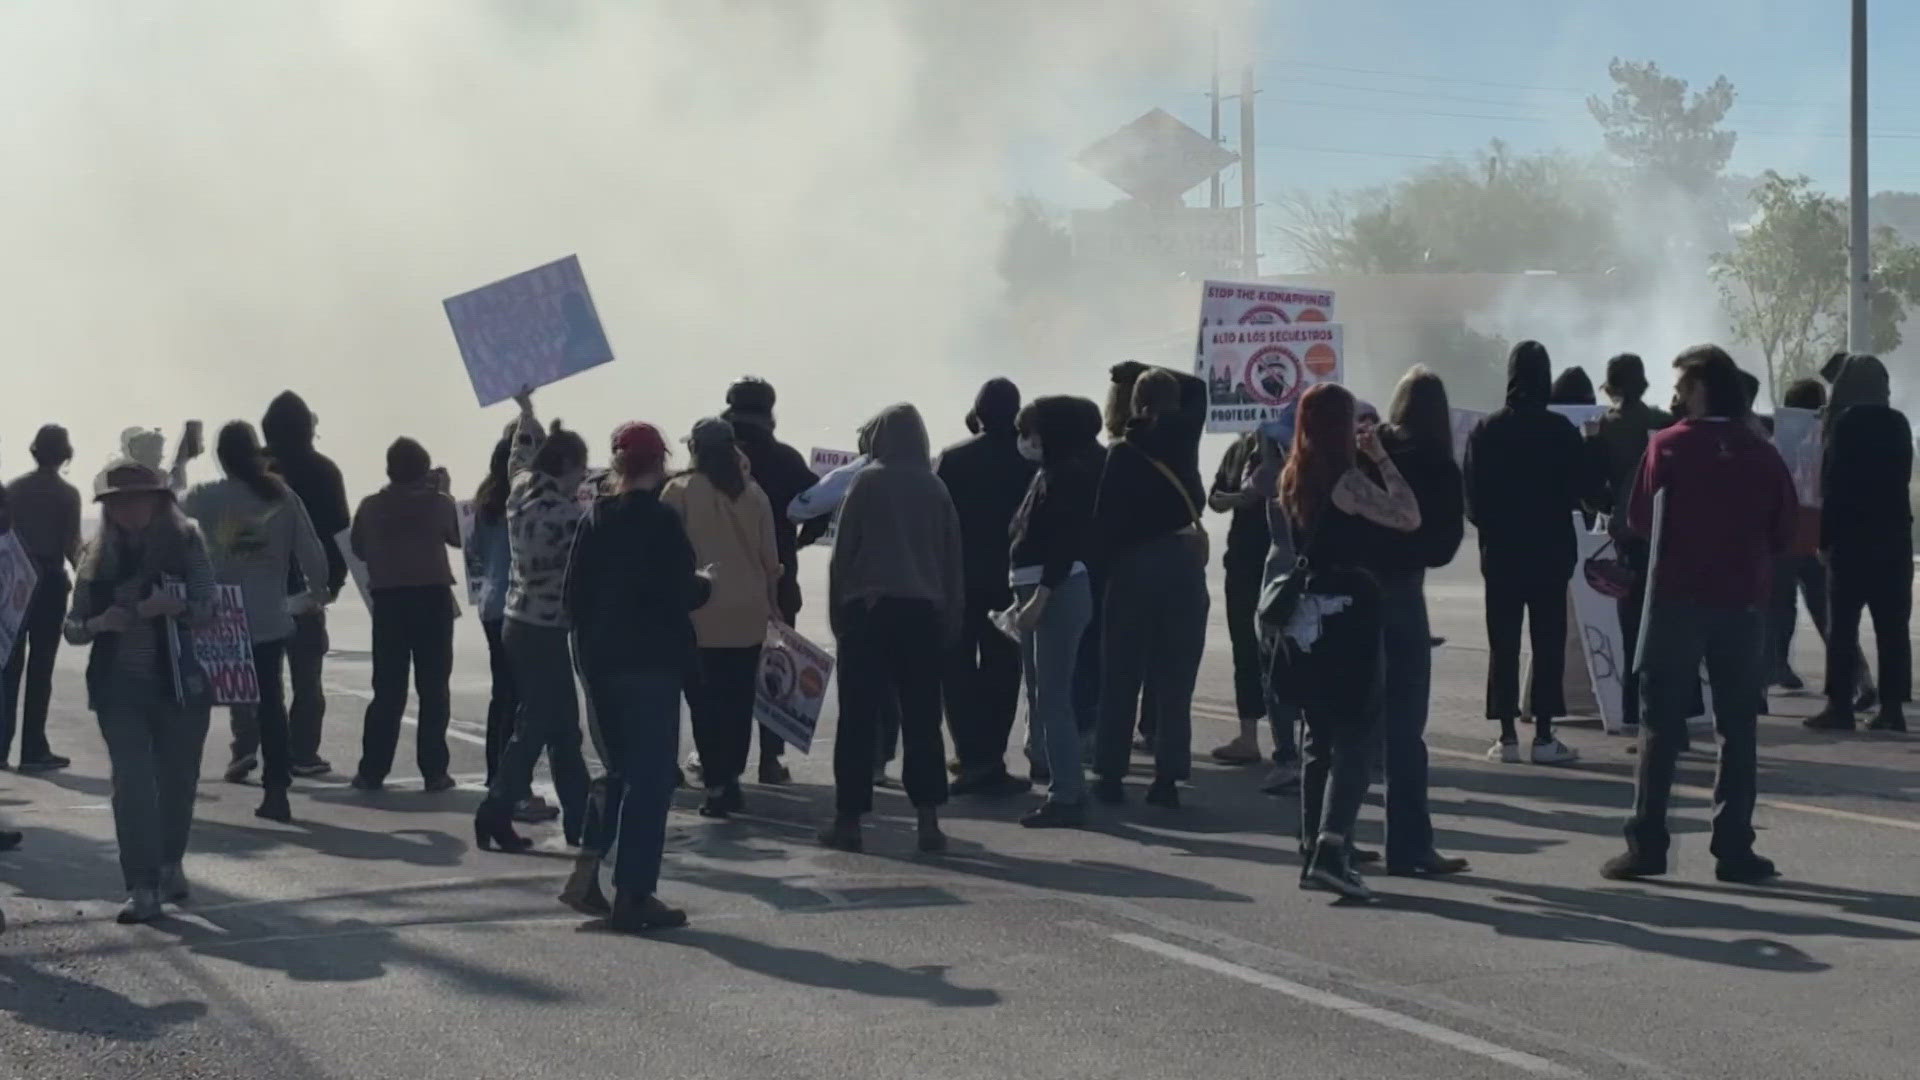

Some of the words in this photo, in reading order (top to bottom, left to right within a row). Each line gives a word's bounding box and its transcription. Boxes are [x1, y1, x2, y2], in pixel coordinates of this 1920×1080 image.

[1207, 286, 1234, 299] STOP
[1237, 288, 1255, 301] THE
[1258, 290, 1331, 307] KIDNAPPINGS
[1212, 333, 1236, 344] ALTO
[1238, 332, 1245, 344] A
[1246, 331, 1266, 343] LOS
[1269, 329, 1333, 342] SECUESTROS
[1211, 408, 1257, 421] PROTEGE
[1260, 407, 1267, 419] A
[815, 452, 839, 465] ALTO
[841, 455, 849, 465] A
